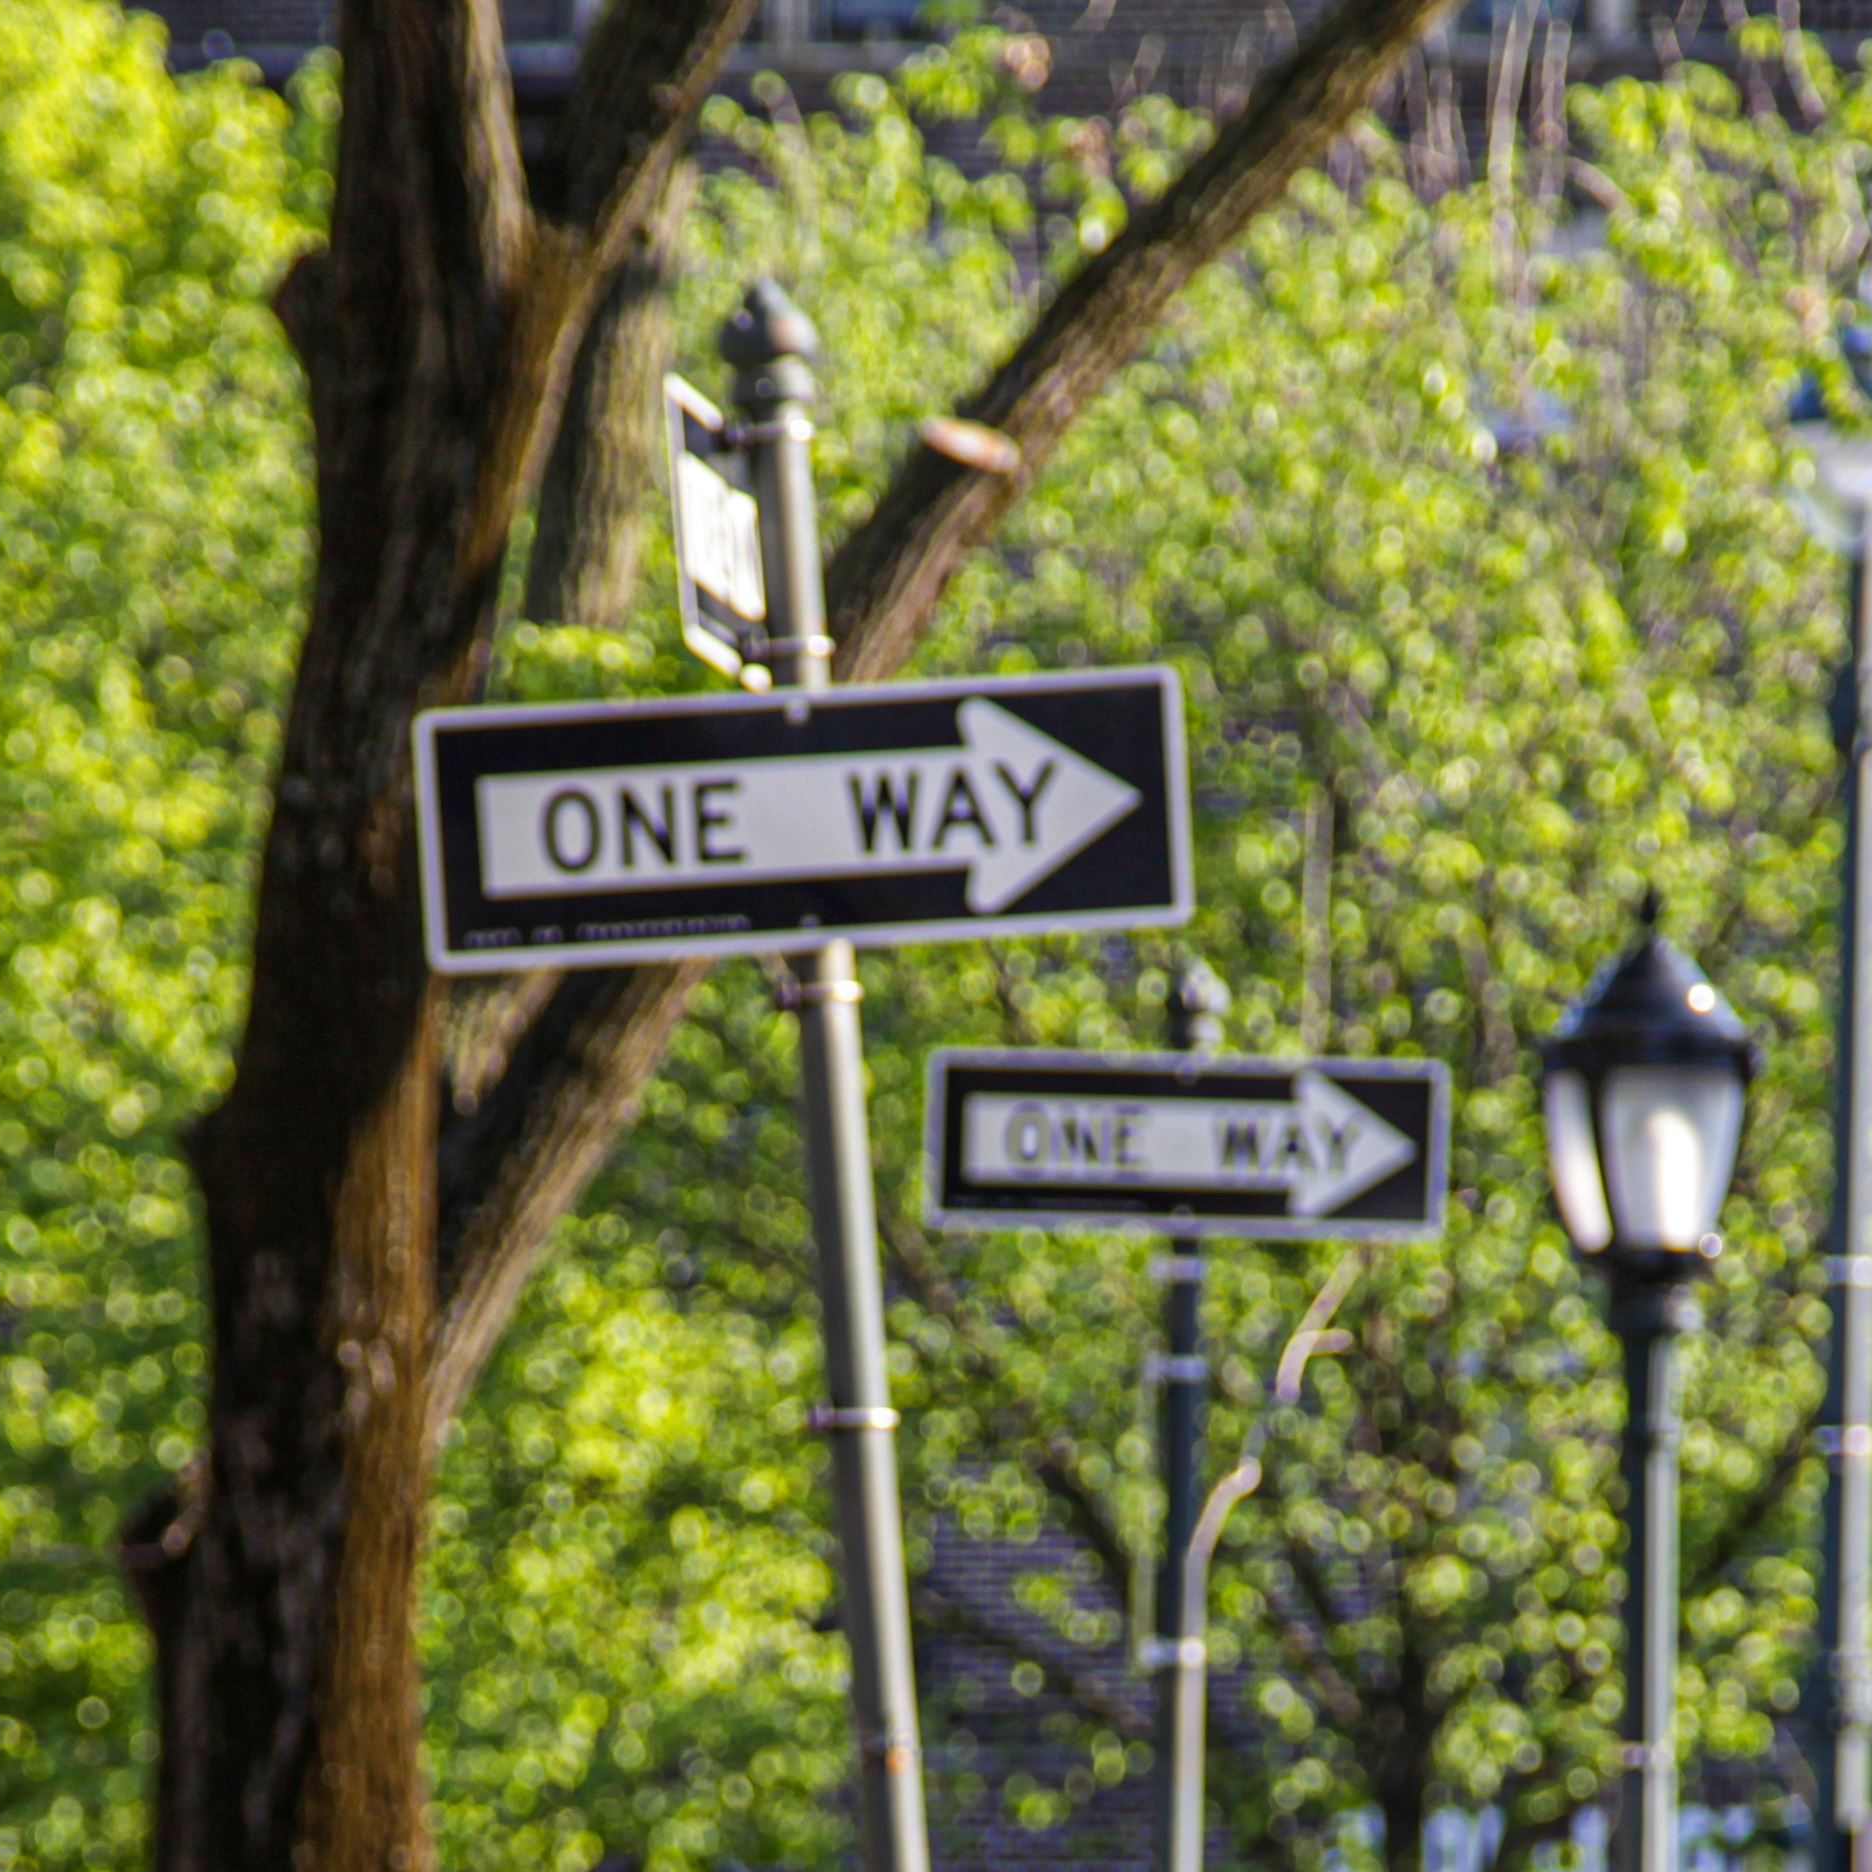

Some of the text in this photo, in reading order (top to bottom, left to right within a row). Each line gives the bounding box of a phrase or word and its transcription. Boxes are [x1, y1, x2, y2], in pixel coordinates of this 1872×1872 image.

[541, 758, 1059, 875] ONE WAY
[1007, 1102, 1367, 1183] ONE WAY
